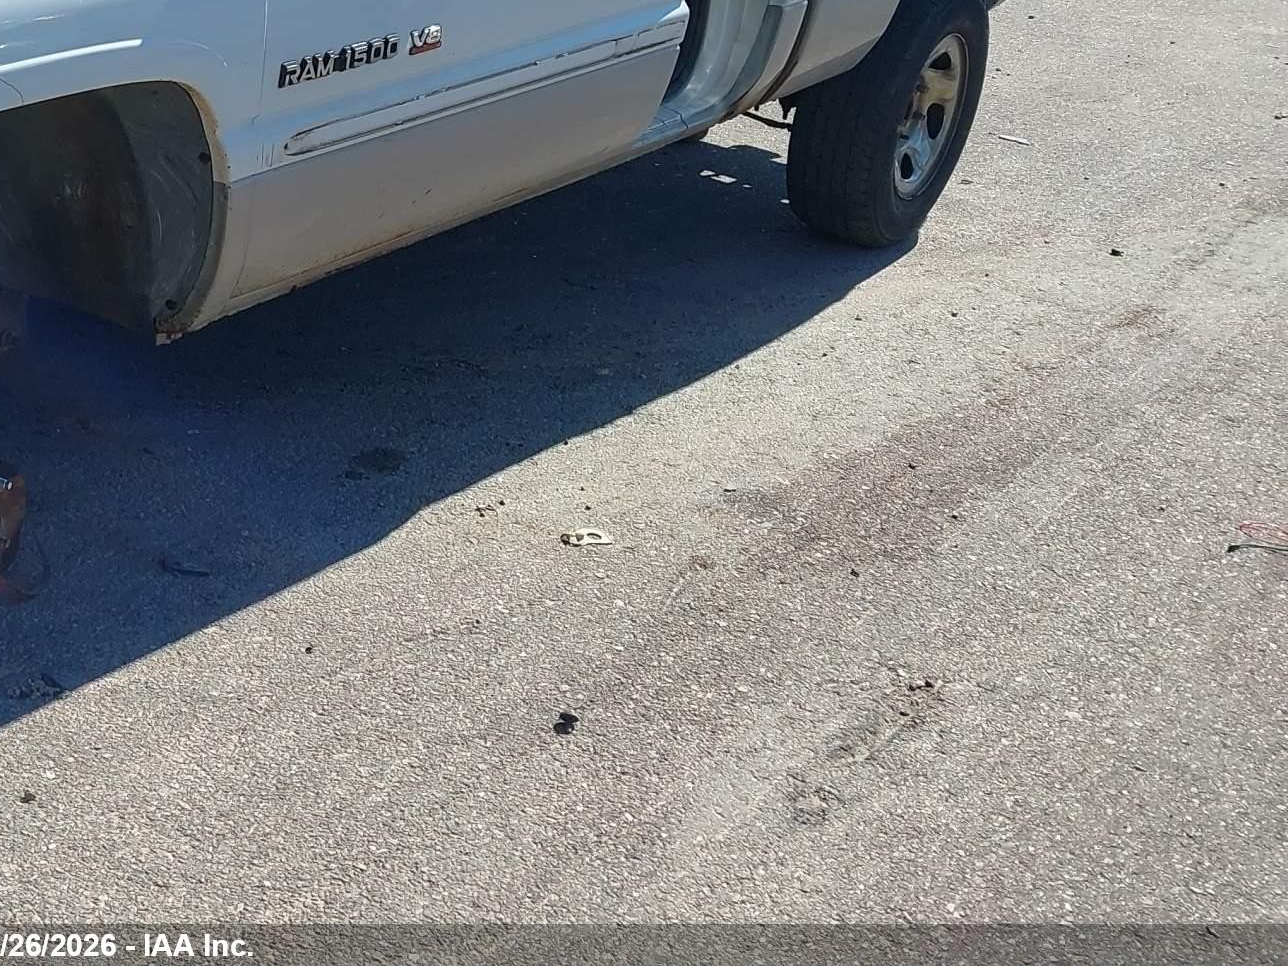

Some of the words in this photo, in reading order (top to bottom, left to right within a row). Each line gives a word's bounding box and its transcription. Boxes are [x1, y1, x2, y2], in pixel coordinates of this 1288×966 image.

[279, 49, 336, 88] RAM
[341, 33, 400, 72] 1500
[410, 24, 442, 49] V8
